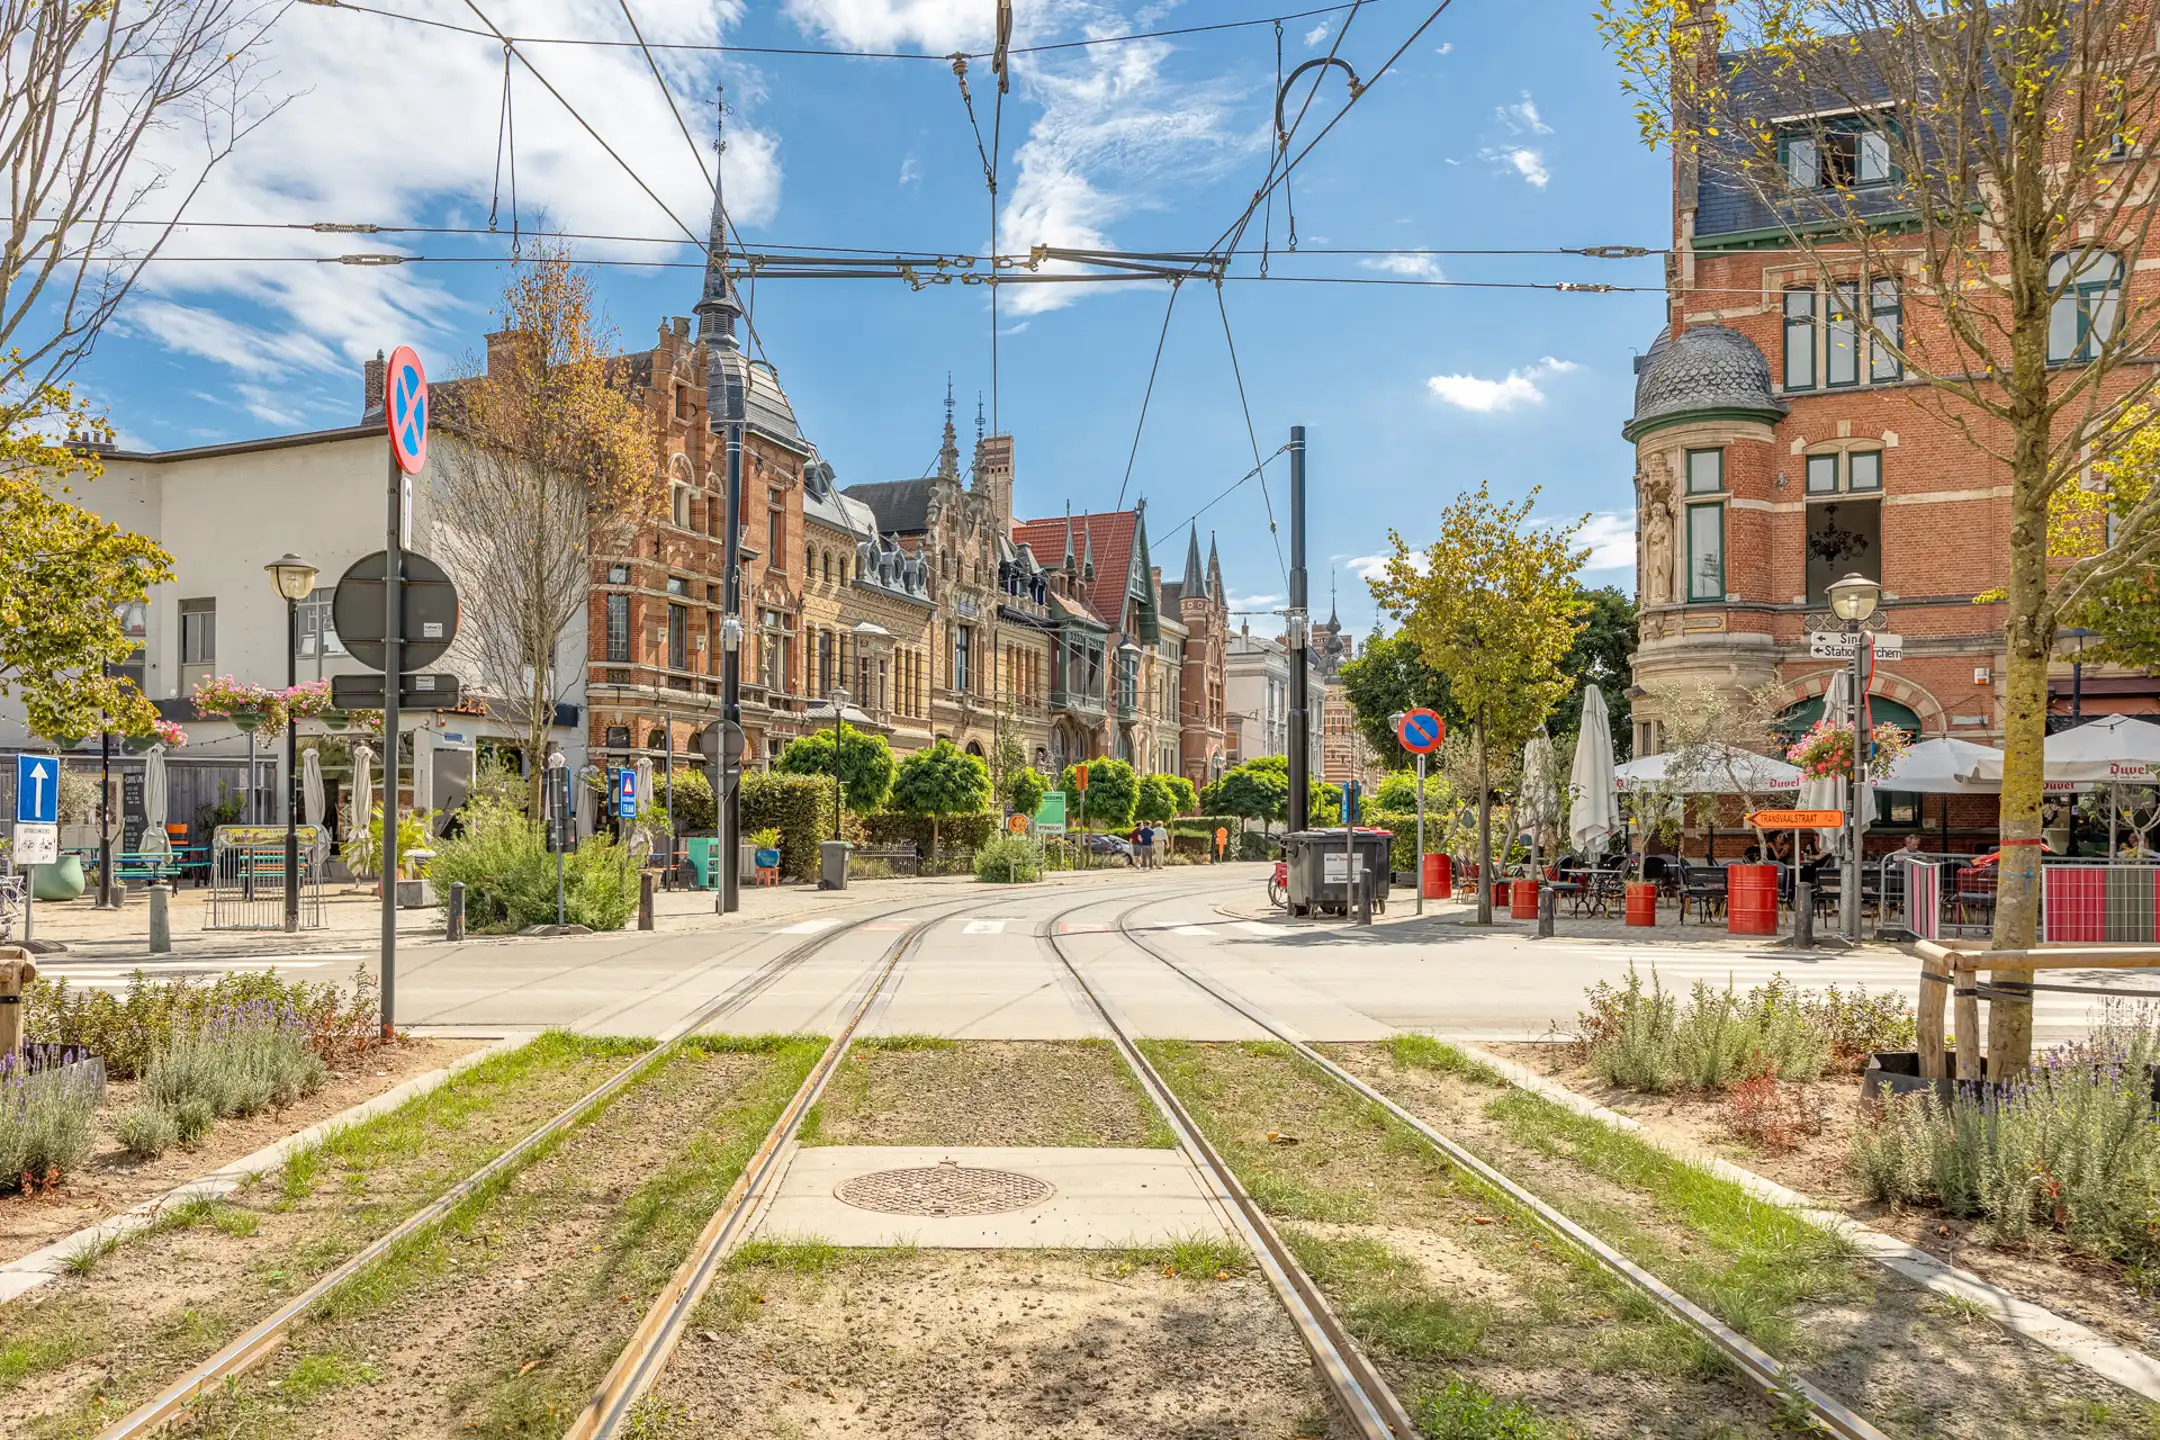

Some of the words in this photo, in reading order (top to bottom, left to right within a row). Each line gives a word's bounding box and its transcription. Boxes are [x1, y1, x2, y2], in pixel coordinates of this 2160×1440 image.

[1840, 633, 1876, 644] Sinl
[1825, 645, 1855, 657] Statio
[1874, 647, 1902, 659] rchem
[2110, 763, 2150, 774] Duvel
[1769, 777, 1800, 788] Duvel
[1761, 813, 1817, 824] TRANSVAALSTRAAT
